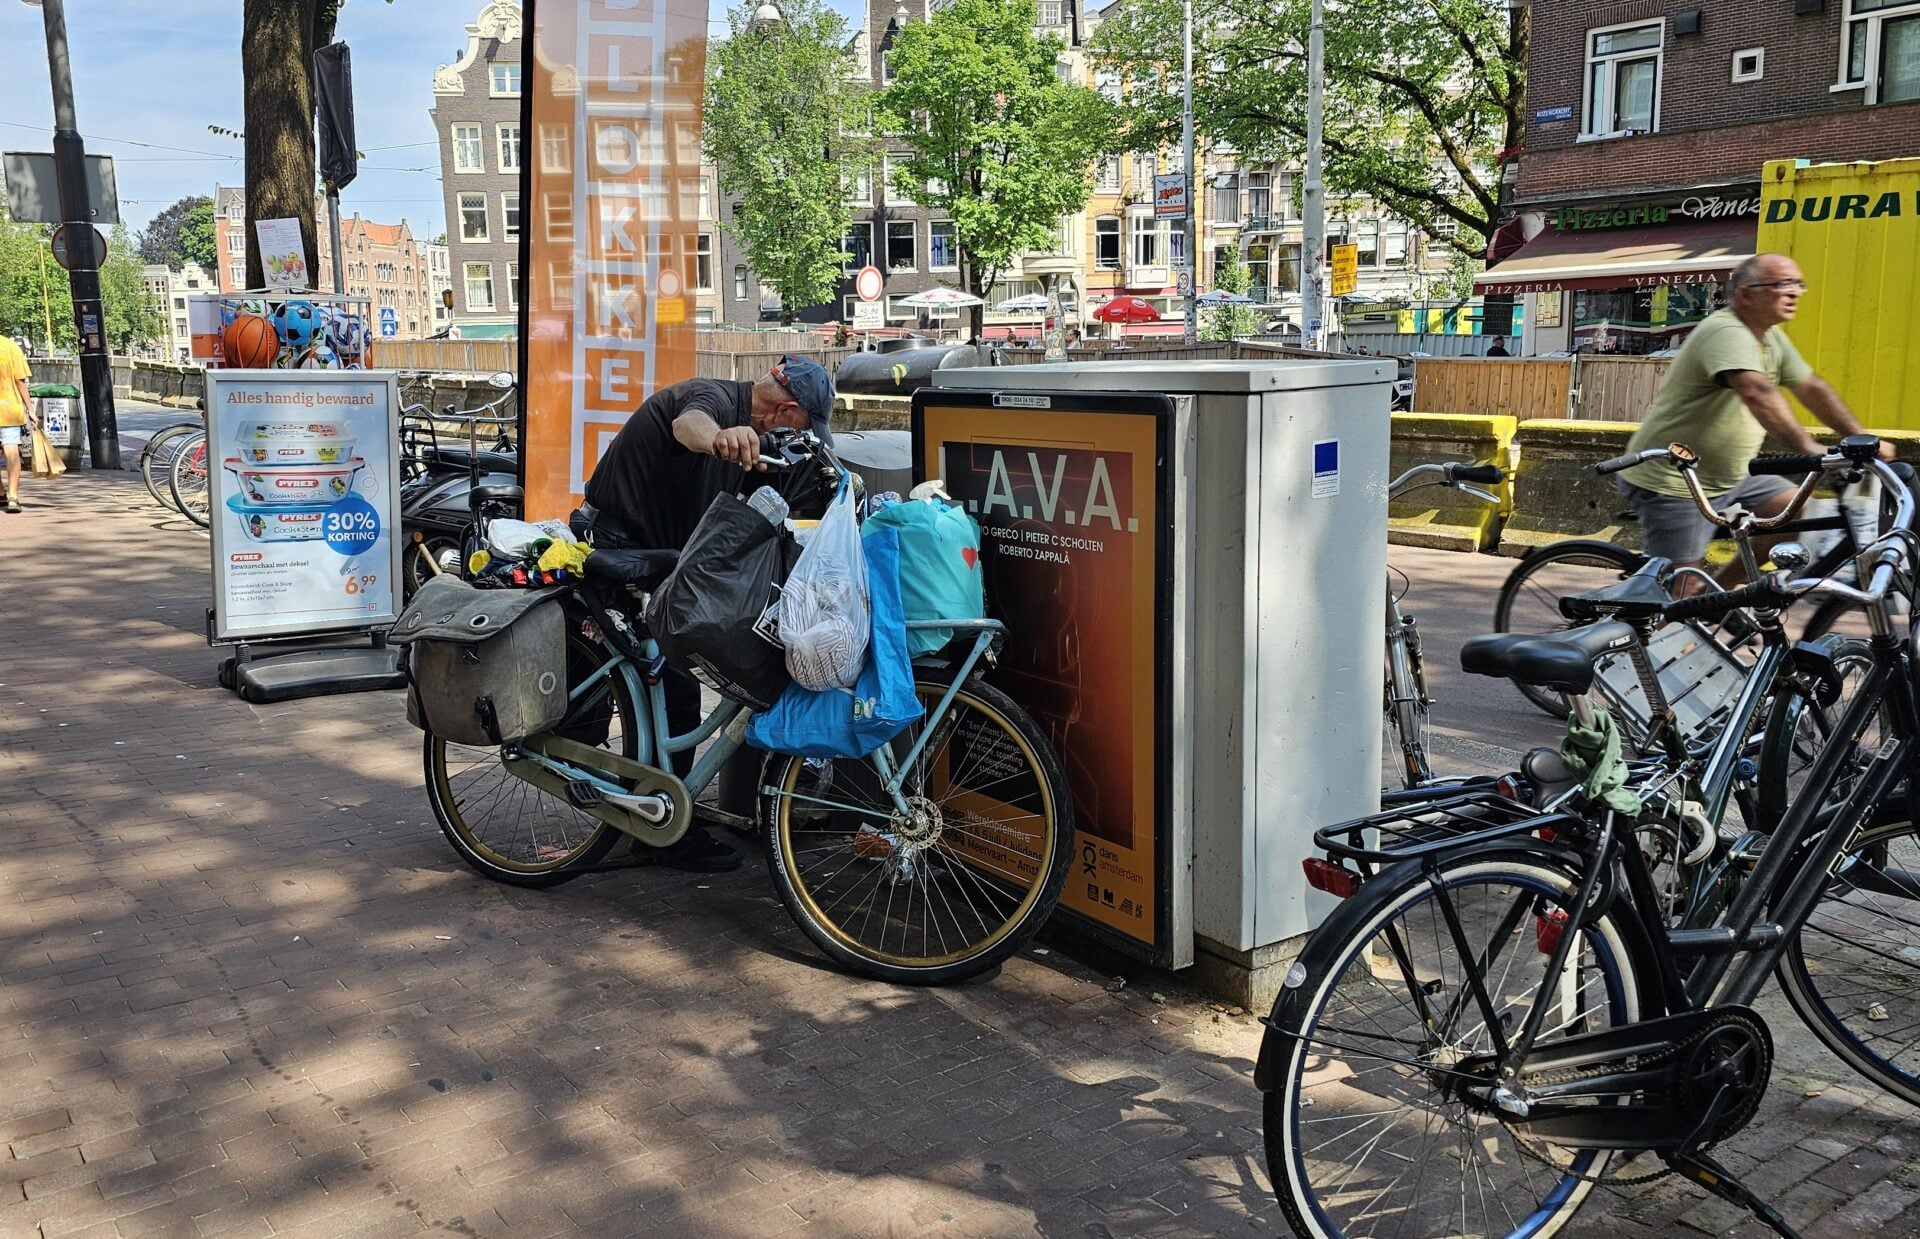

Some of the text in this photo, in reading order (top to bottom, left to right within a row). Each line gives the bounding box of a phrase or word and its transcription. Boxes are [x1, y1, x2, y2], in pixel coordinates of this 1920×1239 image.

[1681, 195, 1761, 218] Venez
[1765, 192, 1901, 224] DURA
[1484, 283, 1563, 295] PIZZERIA
[226, 392, 374, 407] Alles handig bewaard
[328, 512, 376, 530] 30%
[328, 531, 375, 542] KORTING
[990, 528, 1018, 541] GRECO
[1025, 532, 1050, 546] PIETER
[1051, 535, 1058, 546] C
[1060, 536, 1104, 553] SCHOLTEN
[998, 544, 1070, 566] ROBERTO ZAPPALÀ
[345, 575, 377, 595] 6.99
[967, 839, 1008, 864] Meervaart
[1100, 847, 1120, 863] dans
[1099, 860, 1144, 886] amsterdam
